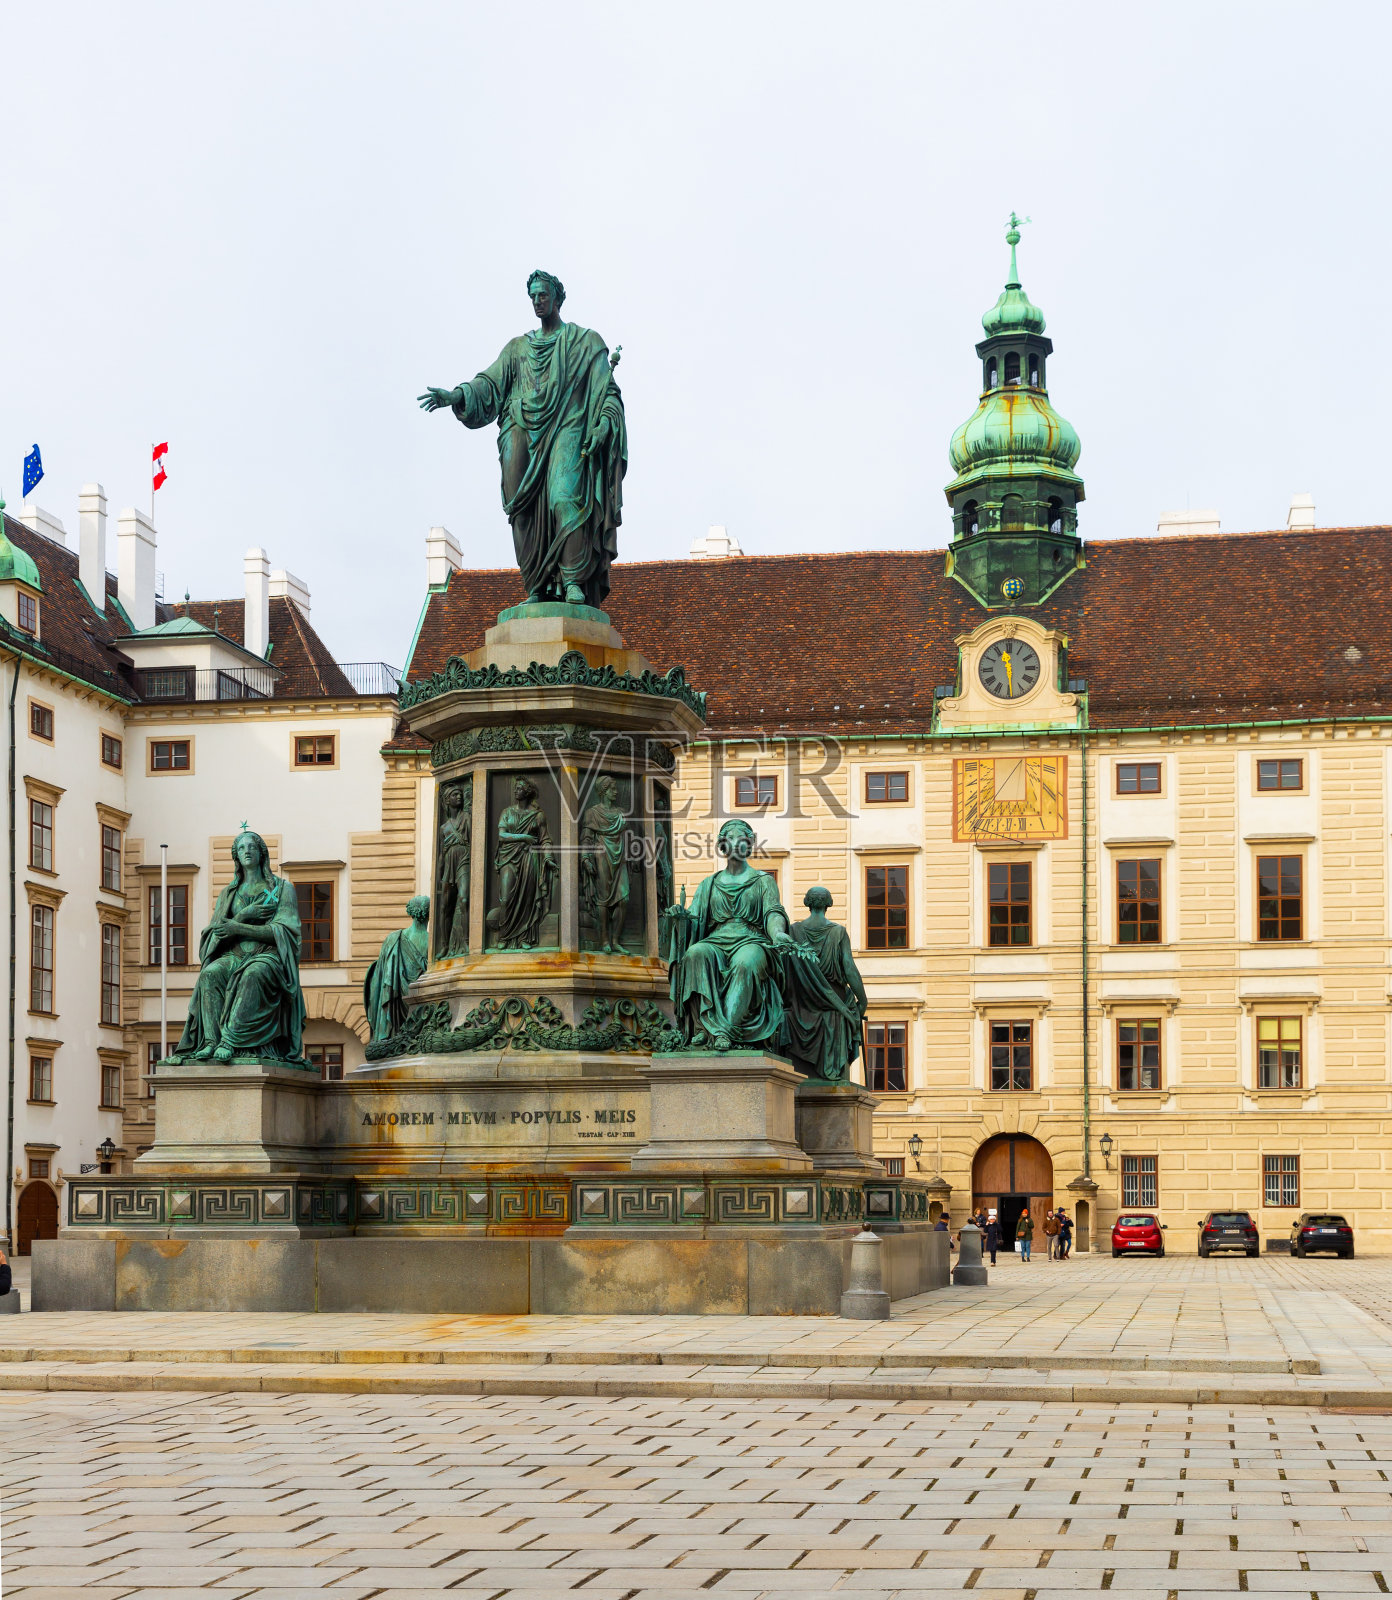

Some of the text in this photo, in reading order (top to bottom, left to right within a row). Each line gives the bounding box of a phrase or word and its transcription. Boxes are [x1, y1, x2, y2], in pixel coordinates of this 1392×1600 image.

[361, 1109, 637, 1126] AMOREM MEVM POPVLIS MEIS
